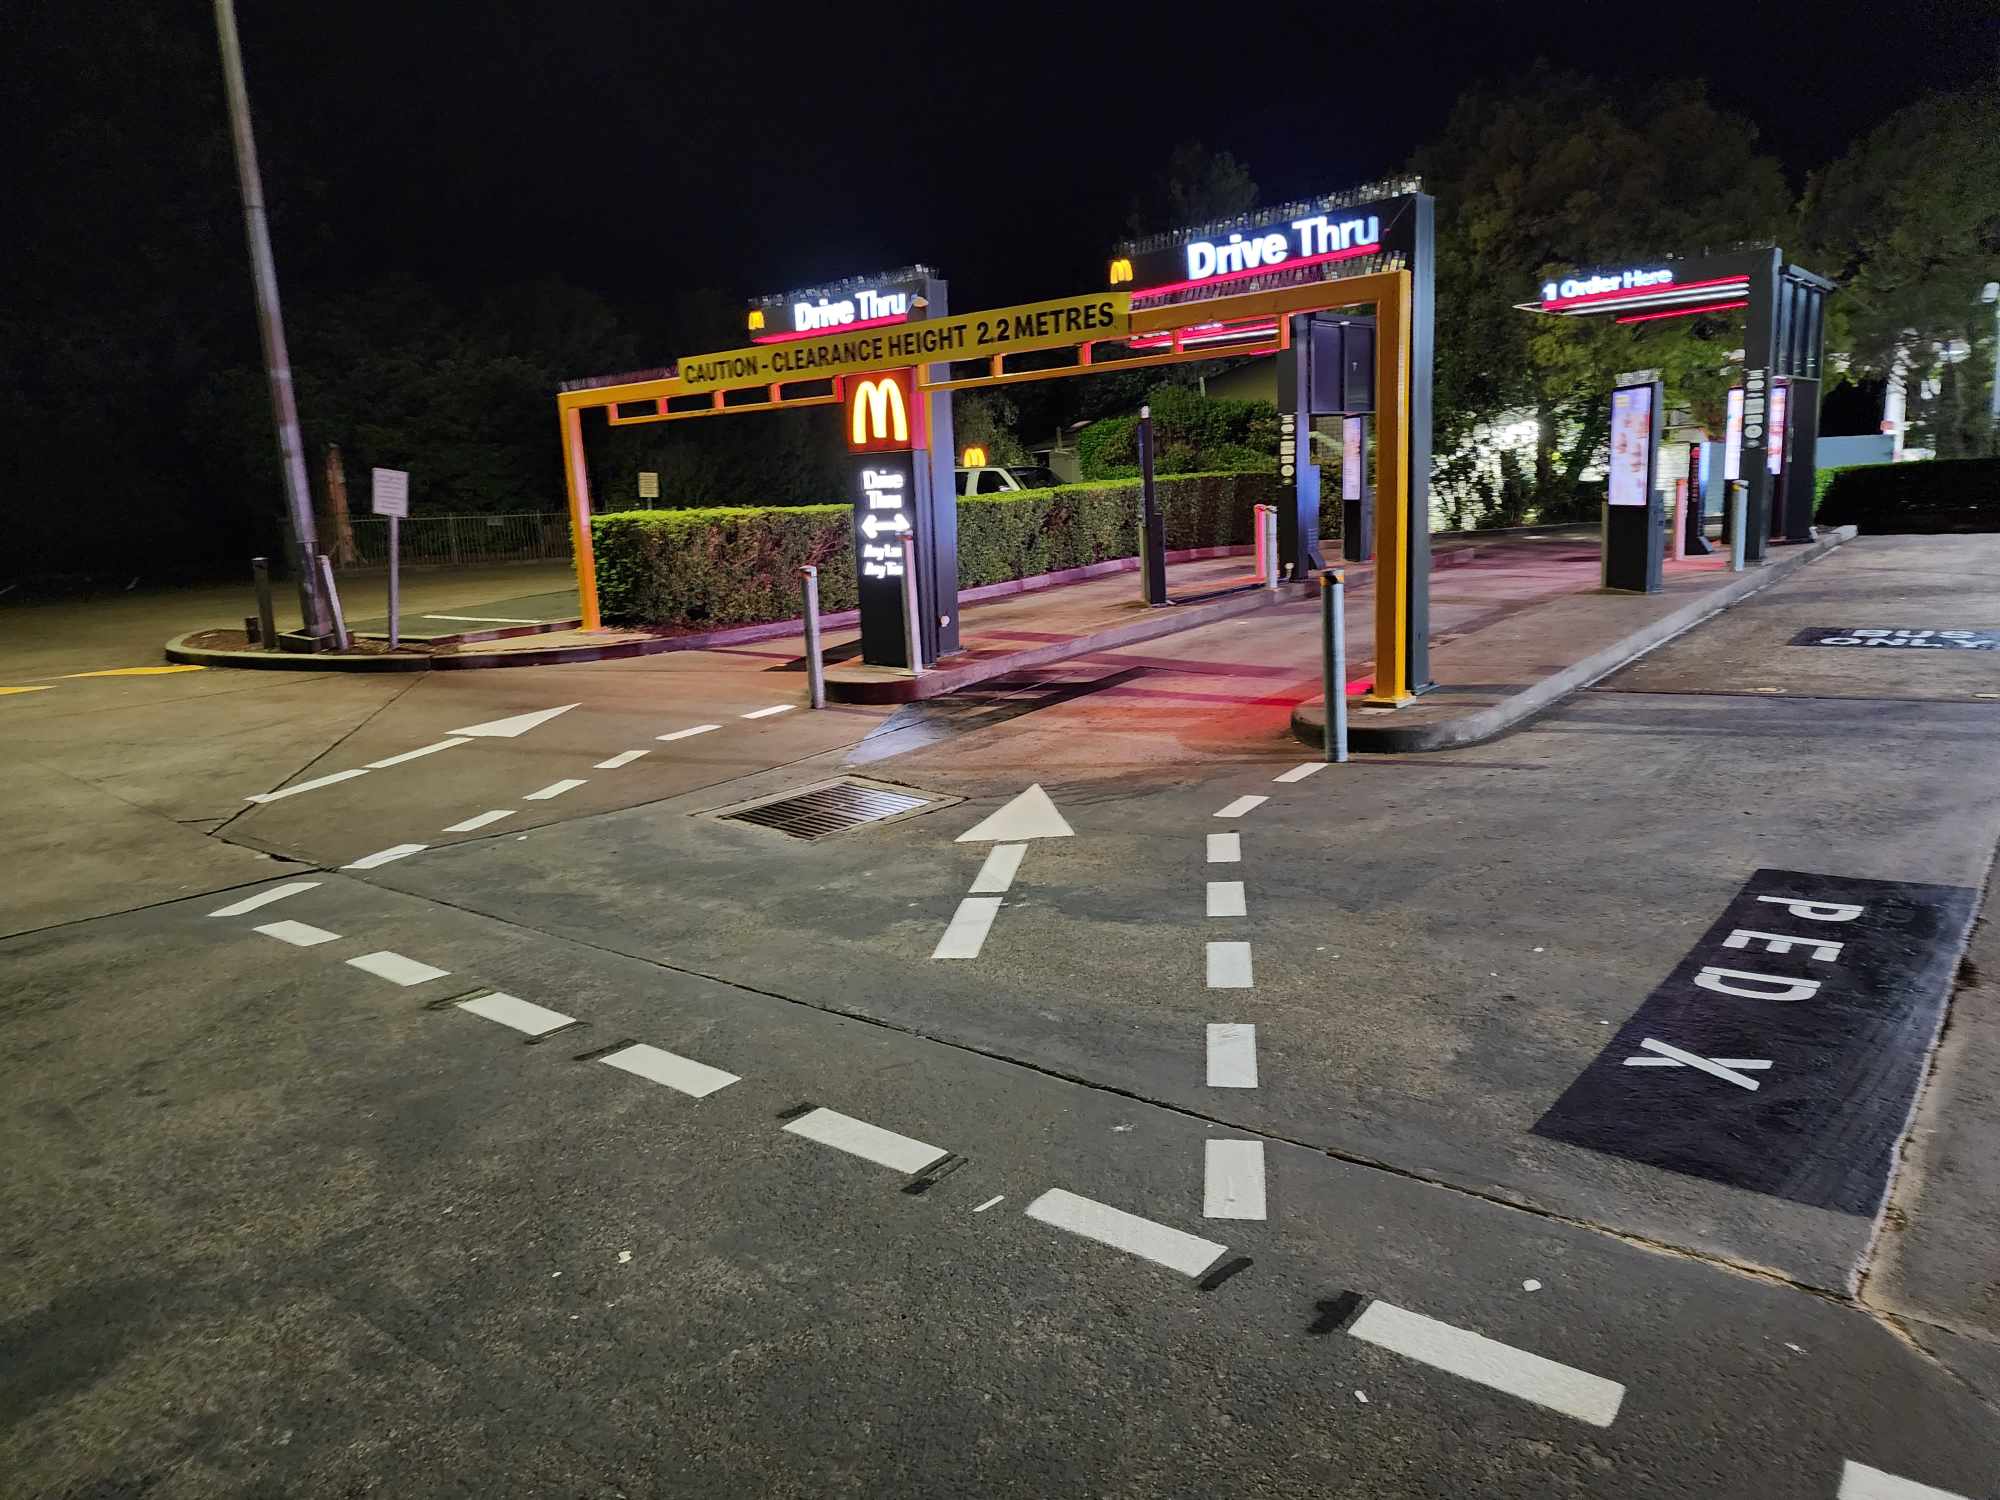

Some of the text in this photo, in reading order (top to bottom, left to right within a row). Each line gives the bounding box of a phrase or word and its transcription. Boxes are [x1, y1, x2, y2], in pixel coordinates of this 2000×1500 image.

[1187, 215, 1379, 281] Drive Thru
[1542, 269, 1673, 301] 1 Order Here
[794, 290, 906, 332] Drive Thru
[683, 356, 758, 384] CAUTION
[771, 339, 882, 373] CLEARANCE
[888, 324, 968, 357] HEIGHT
[976, 318, 1010, 346] 2.2
[1014, 302, 1114, 340] METRES
[1819, 637, 1997, 649] ONLY
[1851, 629, 1976, 639] BUS
[1623, 895, 1865, 1092] PED X
